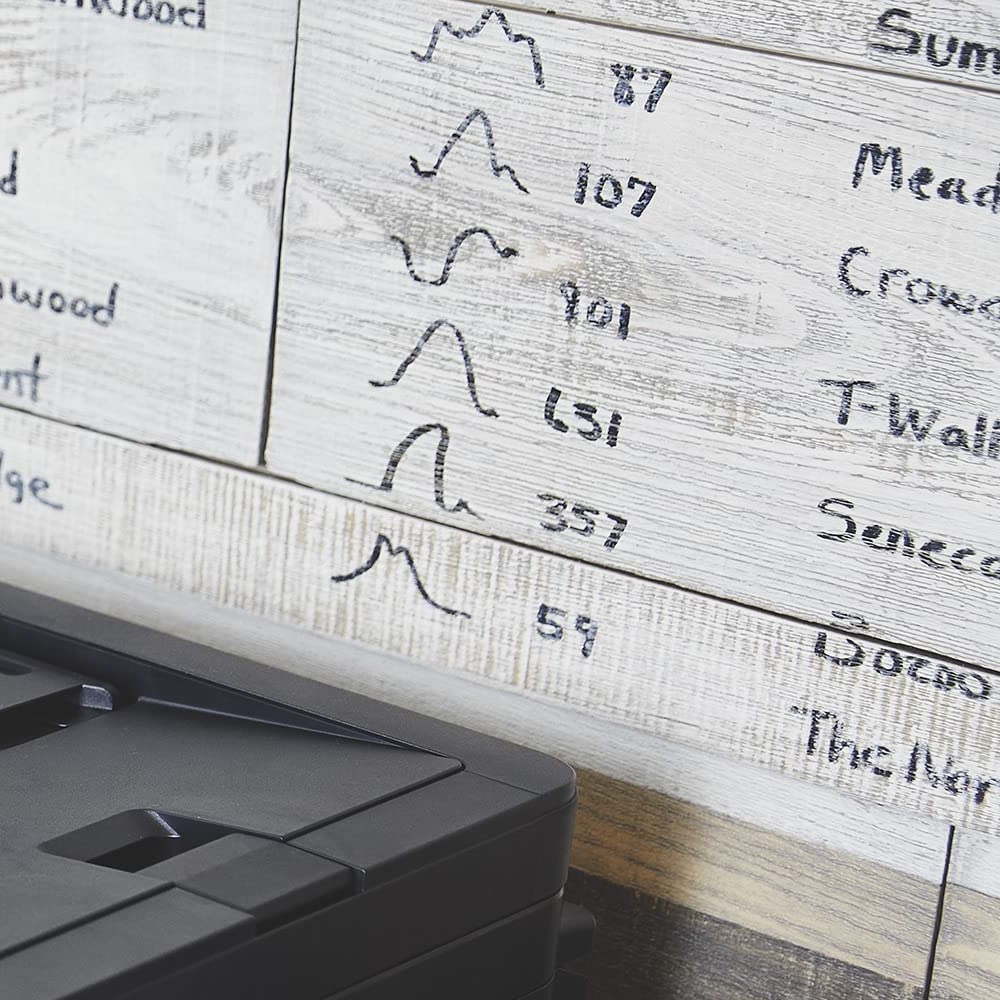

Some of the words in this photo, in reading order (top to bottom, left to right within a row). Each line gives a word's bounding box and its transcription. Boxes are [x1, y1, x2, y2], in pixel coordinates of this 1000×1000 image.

[610, 63, 673, 113] 87
[574, 161, 657, 218] 107
[537, 492, 629, 552] 357
[537, 603, 599, 658] 59
